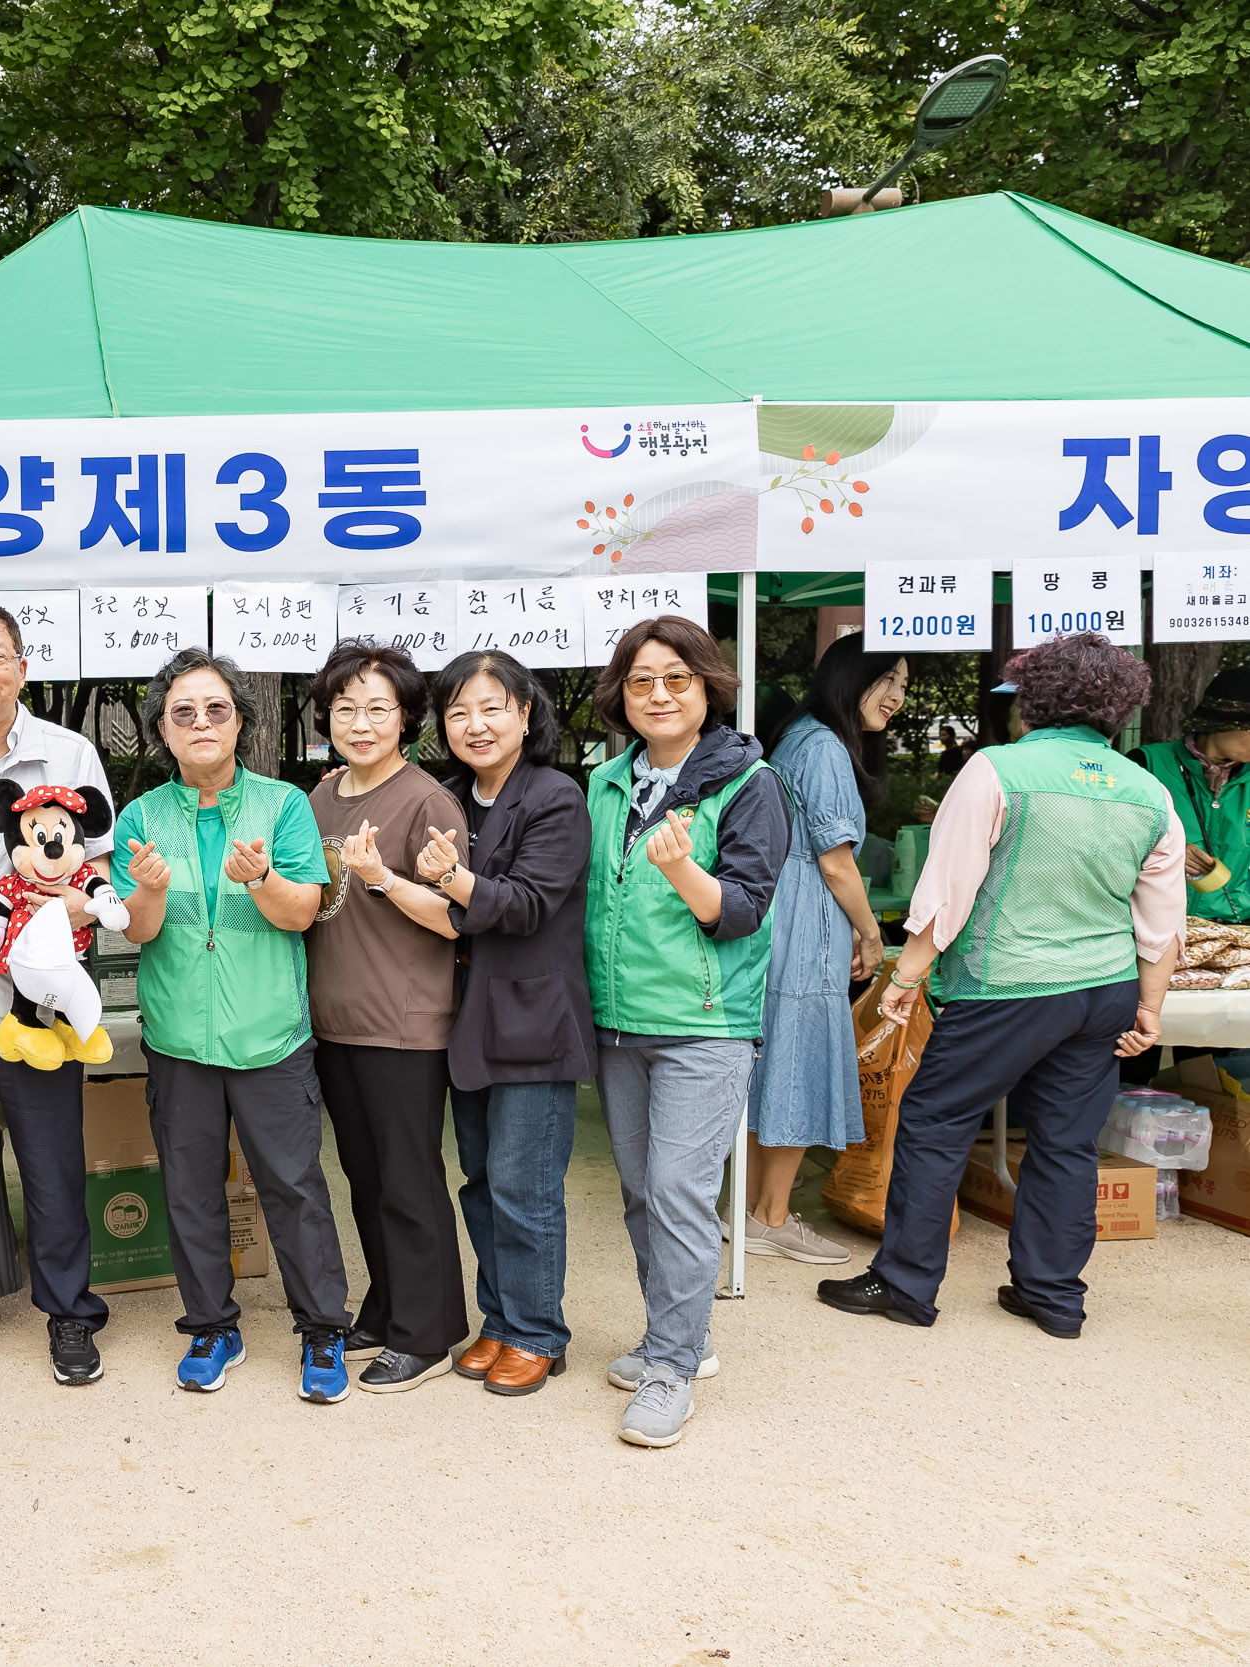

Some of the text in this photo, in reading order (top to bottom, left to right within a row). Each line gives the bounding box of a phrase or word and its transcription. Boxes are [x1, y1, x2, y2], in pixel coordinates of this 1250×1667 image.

[638, 420, 707, 435] 소통하며 발전하는
[638, 433, 708, 457] 행복광진
[1202, 565, 1238, 580] 계좌:
[898, 575, 957, 594] 견과류
[1186, 594, 1247, 606] 새마을금고
[879, 614, 975, 637] 12,000원
[1028, 610, 1125, 634] 10,000원
[238, 631, 317, 652] 13,000원
[471, 628, 571, 651] 11,000원
[1079, 761, 1103, 772] SMU
[1070, 768, 1119, 789] 새마을
[1211, 1113, 1248, 1130] STED
[1213, 1125, 1239, 1141] UTS
